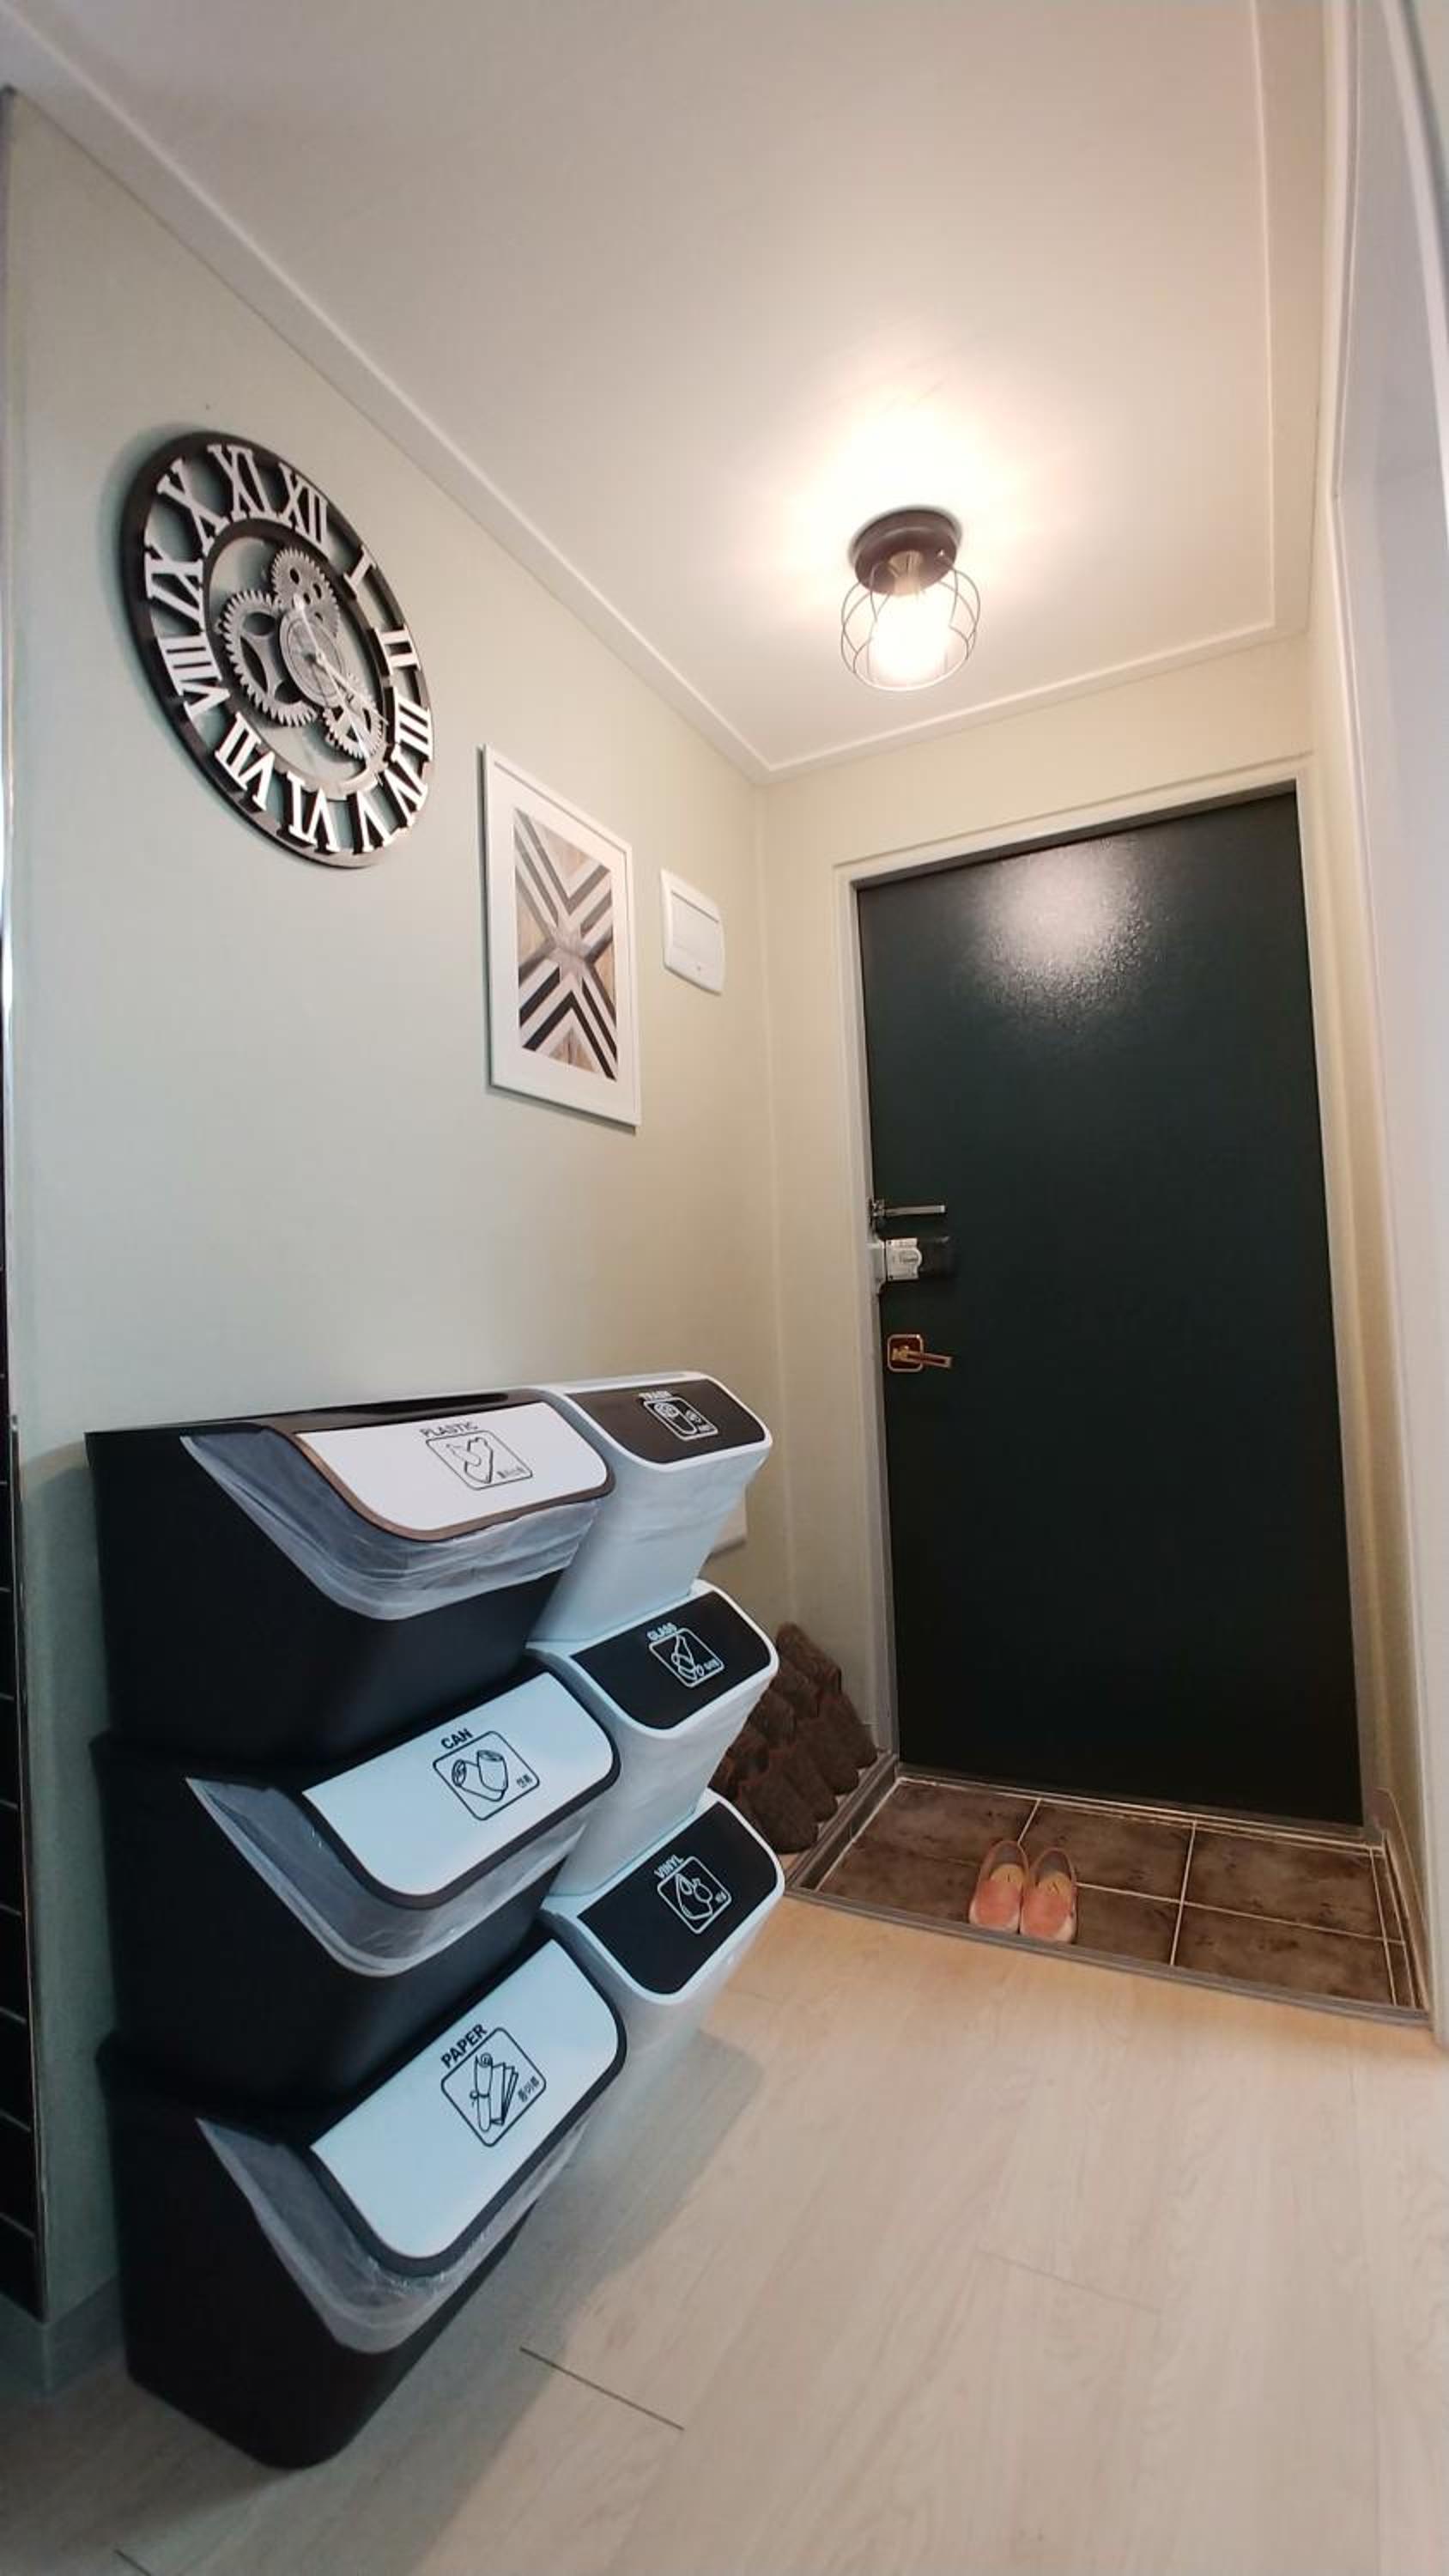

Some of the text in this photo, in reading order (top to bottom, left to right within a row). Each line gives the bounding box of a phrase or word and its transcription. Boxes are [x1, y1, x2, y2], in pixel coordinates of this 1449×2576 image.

[156, 457, 230, 556] X
[343, 544, 377, 596] I
[156, 634, 230, 718] VIII
[375, 623, 421, 675] II
[393, 687, 433, 762] III
[215, 712, 275, 811] VII
[384, 743, 428, 827] IV
[287, 771, 339, 852] VI
[356, 791, 392, 852] V
[420, 1421, 479, 1437] PLASTIC
[646, 1622, 677, 1641] GLASS
[440, 1728, 473, 1749] CAN
[653, 1854, 684, 1879] VINYL
[440, 2024, 488, 2069] PAPER
